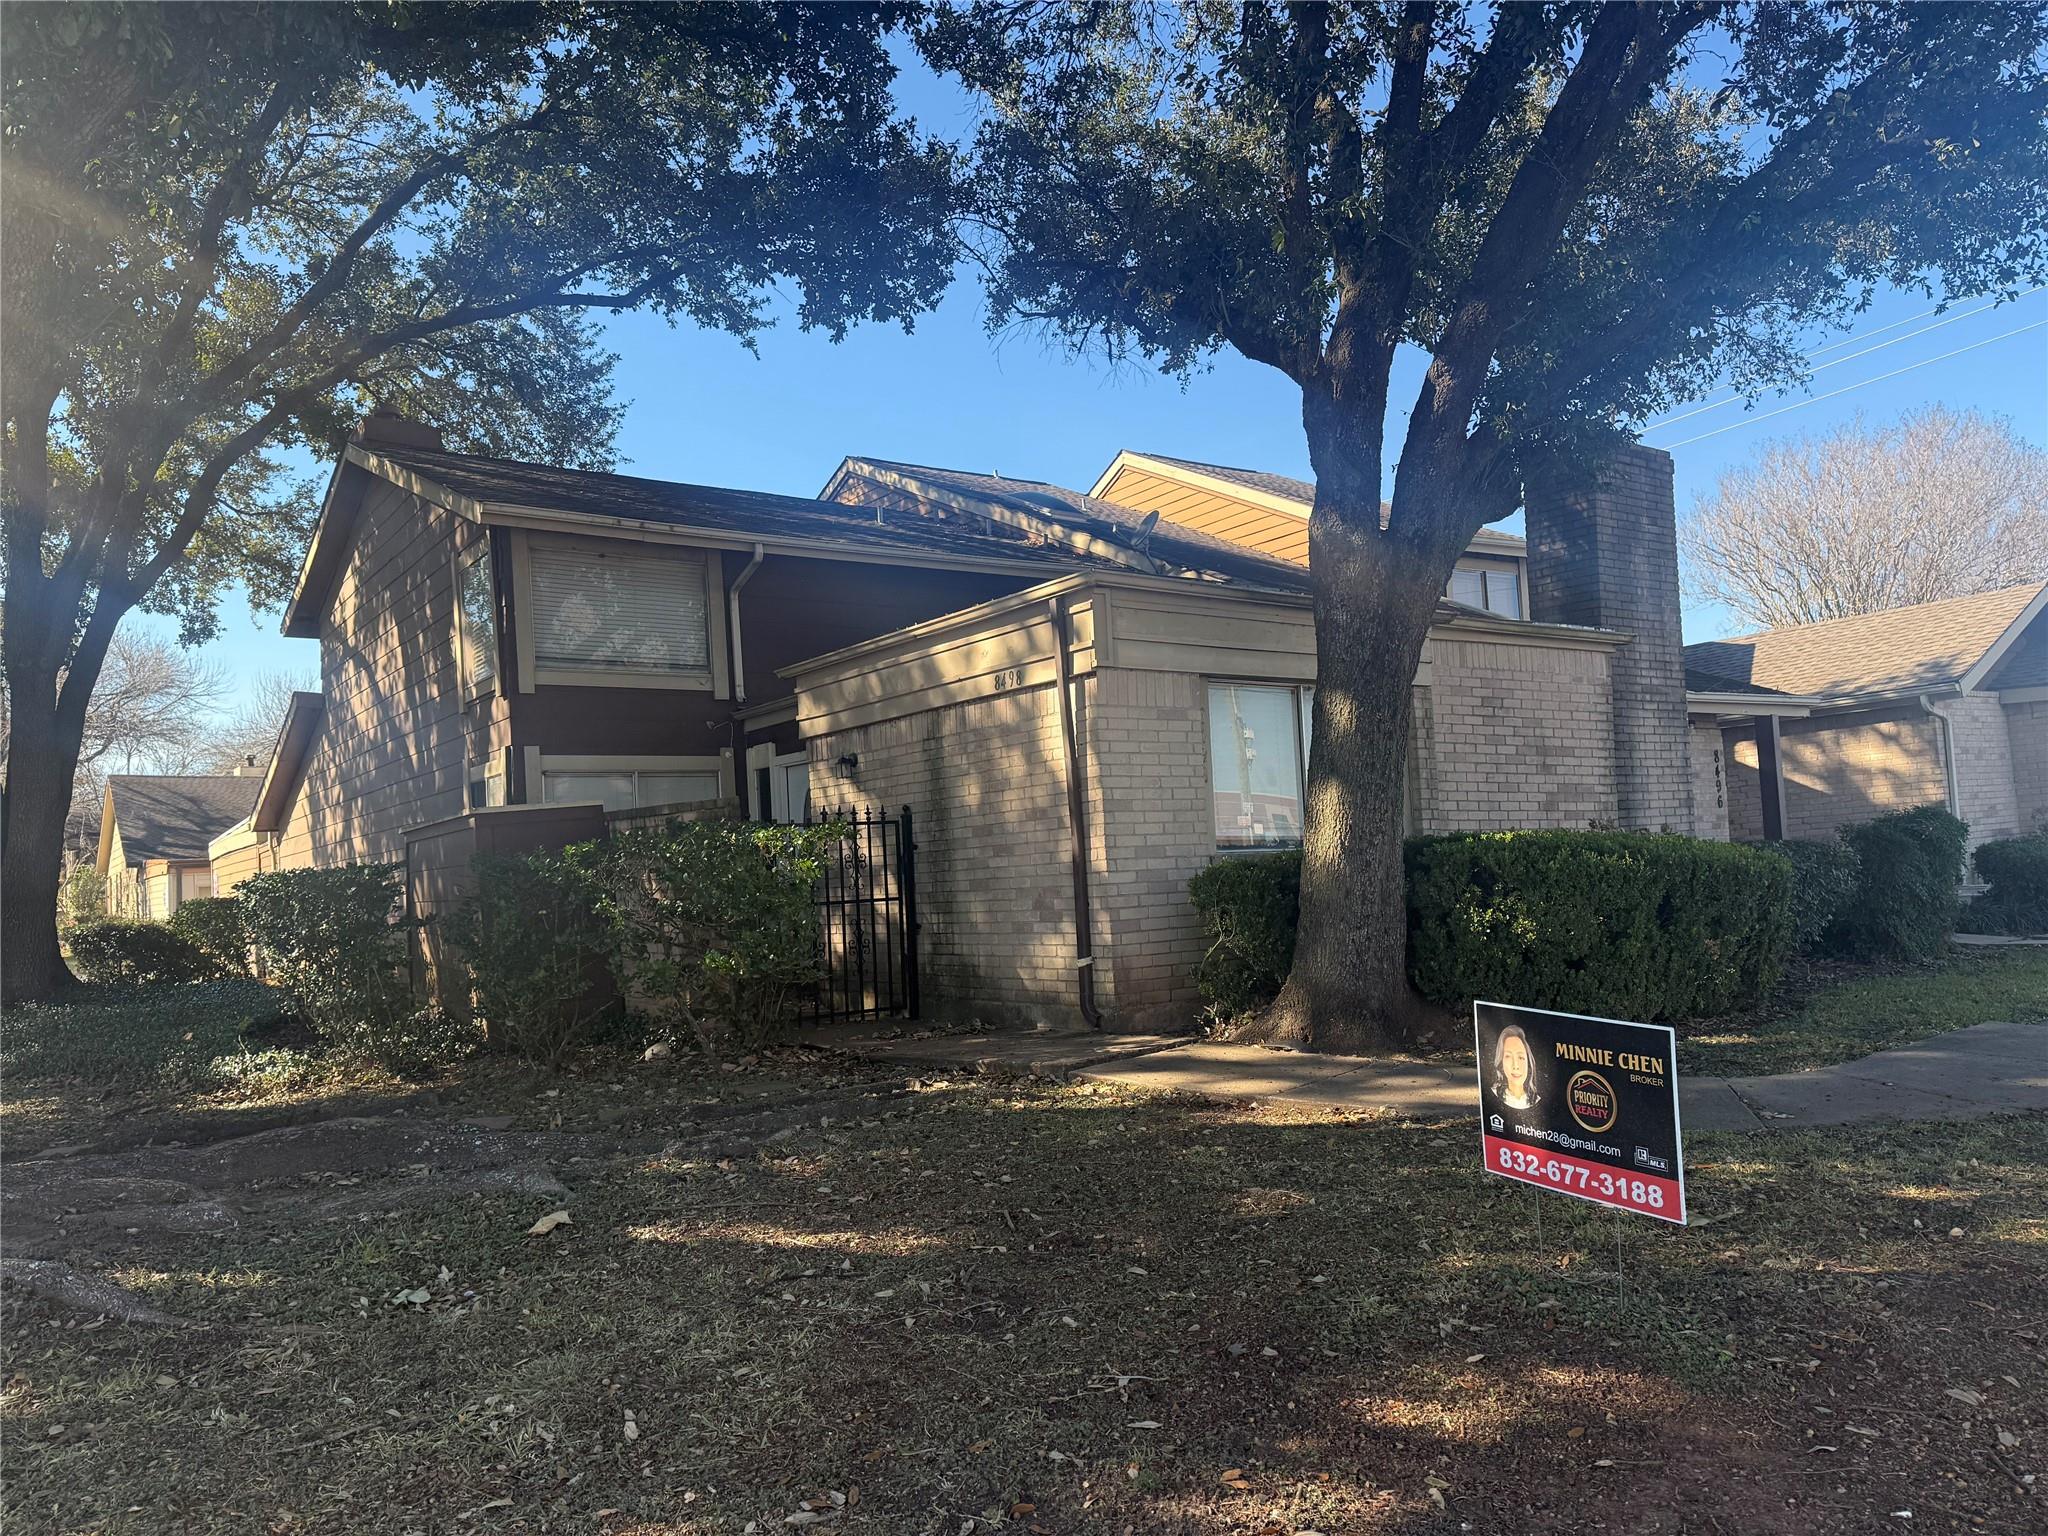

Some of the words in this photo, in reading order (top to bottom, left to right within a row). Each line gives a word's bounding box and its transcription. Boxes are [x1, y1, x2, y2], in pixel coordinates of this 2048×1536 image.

[994, 670, 1021, 690] 8498
[1713, 750, 1723, 808] 8496
[1555, 1043, 1614, 1067] MINNIE
[1618, 1053, 1664, 1074] CHEN
[1630, 1074, 1664, 1087] BROKER
[1574, 1089, 1609, 1108] PRIORITY
[1575, 1105, 1609, 1120] REALTY
[1515, 1124, 1621, 1157] michen28@gmail.com
[1499, 1147, 1664, 1208] 832-677-3188
